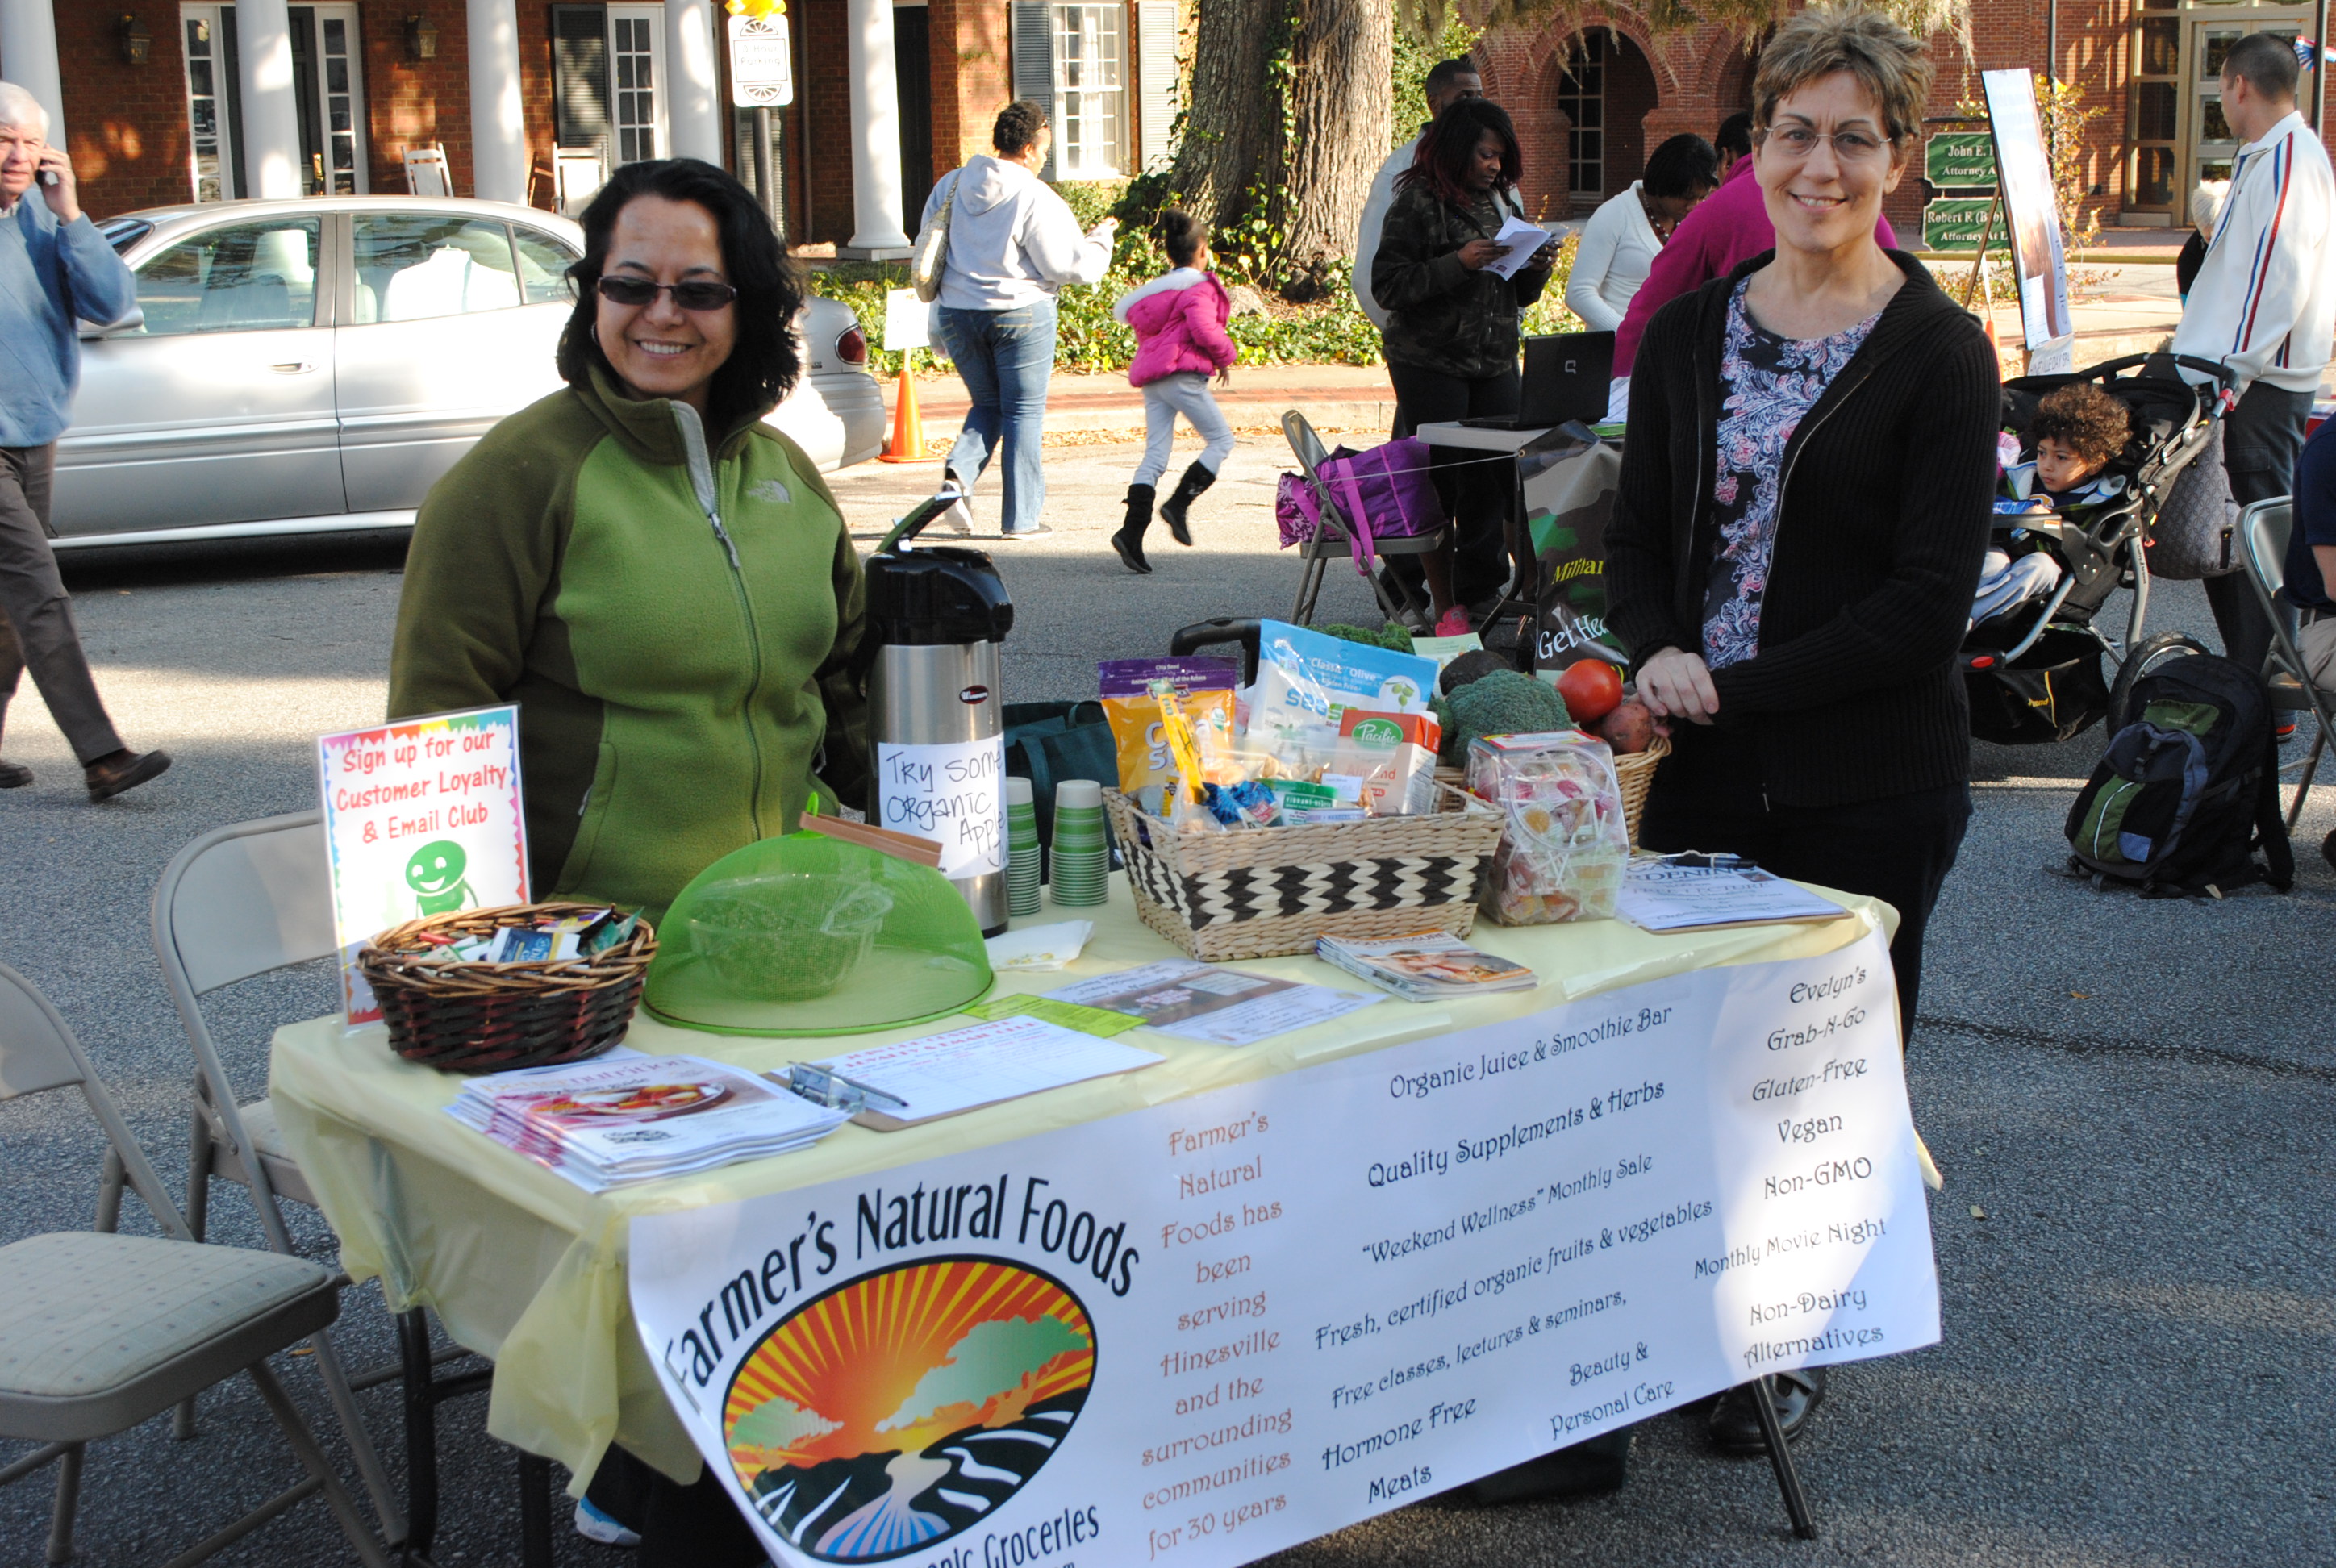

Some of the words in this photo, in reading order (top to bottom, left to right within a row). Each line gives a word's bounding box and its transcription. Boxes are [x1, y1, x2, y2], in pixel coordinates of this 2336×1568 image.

[740, 56, 781, 66] Parking
[1942, 166, 1985, 177] Attorney
[1947, 145, 1973, 157] John
[1975, 145, 1987, 157] E.
[1927, 211, 1963, 223] Robert
[1964, 211, 1974, 223] F.
[1975, 211, 2004, 225] (Bb)
[1940, 231, 1983, 243] Attorney
[1538, 624, 1579, 660] Get
[1349, 667, 1377, 682] Olive
[342, 748, 386, 775] Sign
[394, 744, 417, 769] up
[424, 736, 455, 758] for
[463, 732, 495, 752] our
[1358, 723, 1400, 749] Pacific
[336, 778, 432, 811] Customer
[439, 764, 507, 795] Loyalty
[362, 820, 379, 844] &
[388, 809, 440, 839] Email
[448, 801, 489, 828] Club
[959, 808, 1006, 855] Apple
[1789, 965, 1867, 1003] Evelyn's
[1767, 1006, 1866, 1051] Grab-N-Go
[1390, 1062, 1475, 1099] Organic
[1479, 1049, 1529, 1079] Juice
[1533, 1040, 1547, 1062] &
[1550, 1014, 1633, 1057] Smoothie
[1637, 1007, 1672, 1032] Bar
[1752, 1057, 1868, 1102] Gluten-Free
[1169, 1111, 1269, 1157] Farmer's
[1367, 1148, 1449, 1188] Quality
[1455, 1105, 1584, 1163] Supplements
[1590, 1097, 1604, 1120] &
[1607, 1080, 1665, 1114] Herbs
[1777, 1114, 1842, 1143] Vegan
[1179, 1154, 1262, 1200] Natural
[1548, 1166, 1612, 1204] Monthly
[1616, 1153, 1654, 1180] Sale
[1764, 1157, 1872, 1199] Non-GMO
[1161, 1211, 1236, 1249] Foods
[1242, 1201, 1283, 1227] has
[1196, 1254, 1251, 1284] been
[1694, 1245, 1761, 1279] Monthly
[1766, 1229, 1821, 1257] Movie
[1828, 1217, 1887, 1245] Night
[665, 1210, 839, 1413] Farmer's
[856, 1173, 1009, 1261] Natural
[1018, 1175, 1140, 1298] Foods
[1315, 1317, 1382, 1350] Fresh,
[1387, 1280, 1468, 1327] certified
[1473, 1256, 1544, 1297] organic
[1547, 1236, 1595, 1274] fruits
[1599, 1228, 1614, 1249] &
[1617, 1199, 1713, 1244] vegetables
[1178, 1291, 1266, 1331] serving
[1750, 1289, 1867, 1326] Non-Dairy
[1160, 1328, 1281, 1378] Hinesville
[1332, 1382, 1374, 1409] Free
[1378, 1353, 1451, 1391] classes,
[1455, 1327, 1524, 1365] lectures
[1527, 1315, 1541, 1336] &
[1544, 1291, 1627, 1330] seminars,
[1569, 1350, 1630, 1387] Beauty
[1634, 1341, 1650, 1361] &
[1743, 1326, 1884, 1369] Alternatives
[1174, 1382, 1220, 1416] and
[1228, 1376, 1264, 1402] the
[1550, 1391, 1630, 1441] Personal
[1633, 1380, 1675, 1407] Care
[1141, 1407, 1292, 1467] surrounding
[1320, 1419, 1424, 1470] Hormone
[1429, 1397, 1477, 1429] Free
[1142, 1452, 1291, 1511] communities
[1367, 1463, 1433, 1505] Meats
[1149, 1525, 1182, 1562] for
[1187, 1512, 1215, 1541] 30
[1223, 1494, 1287, 1534] years
